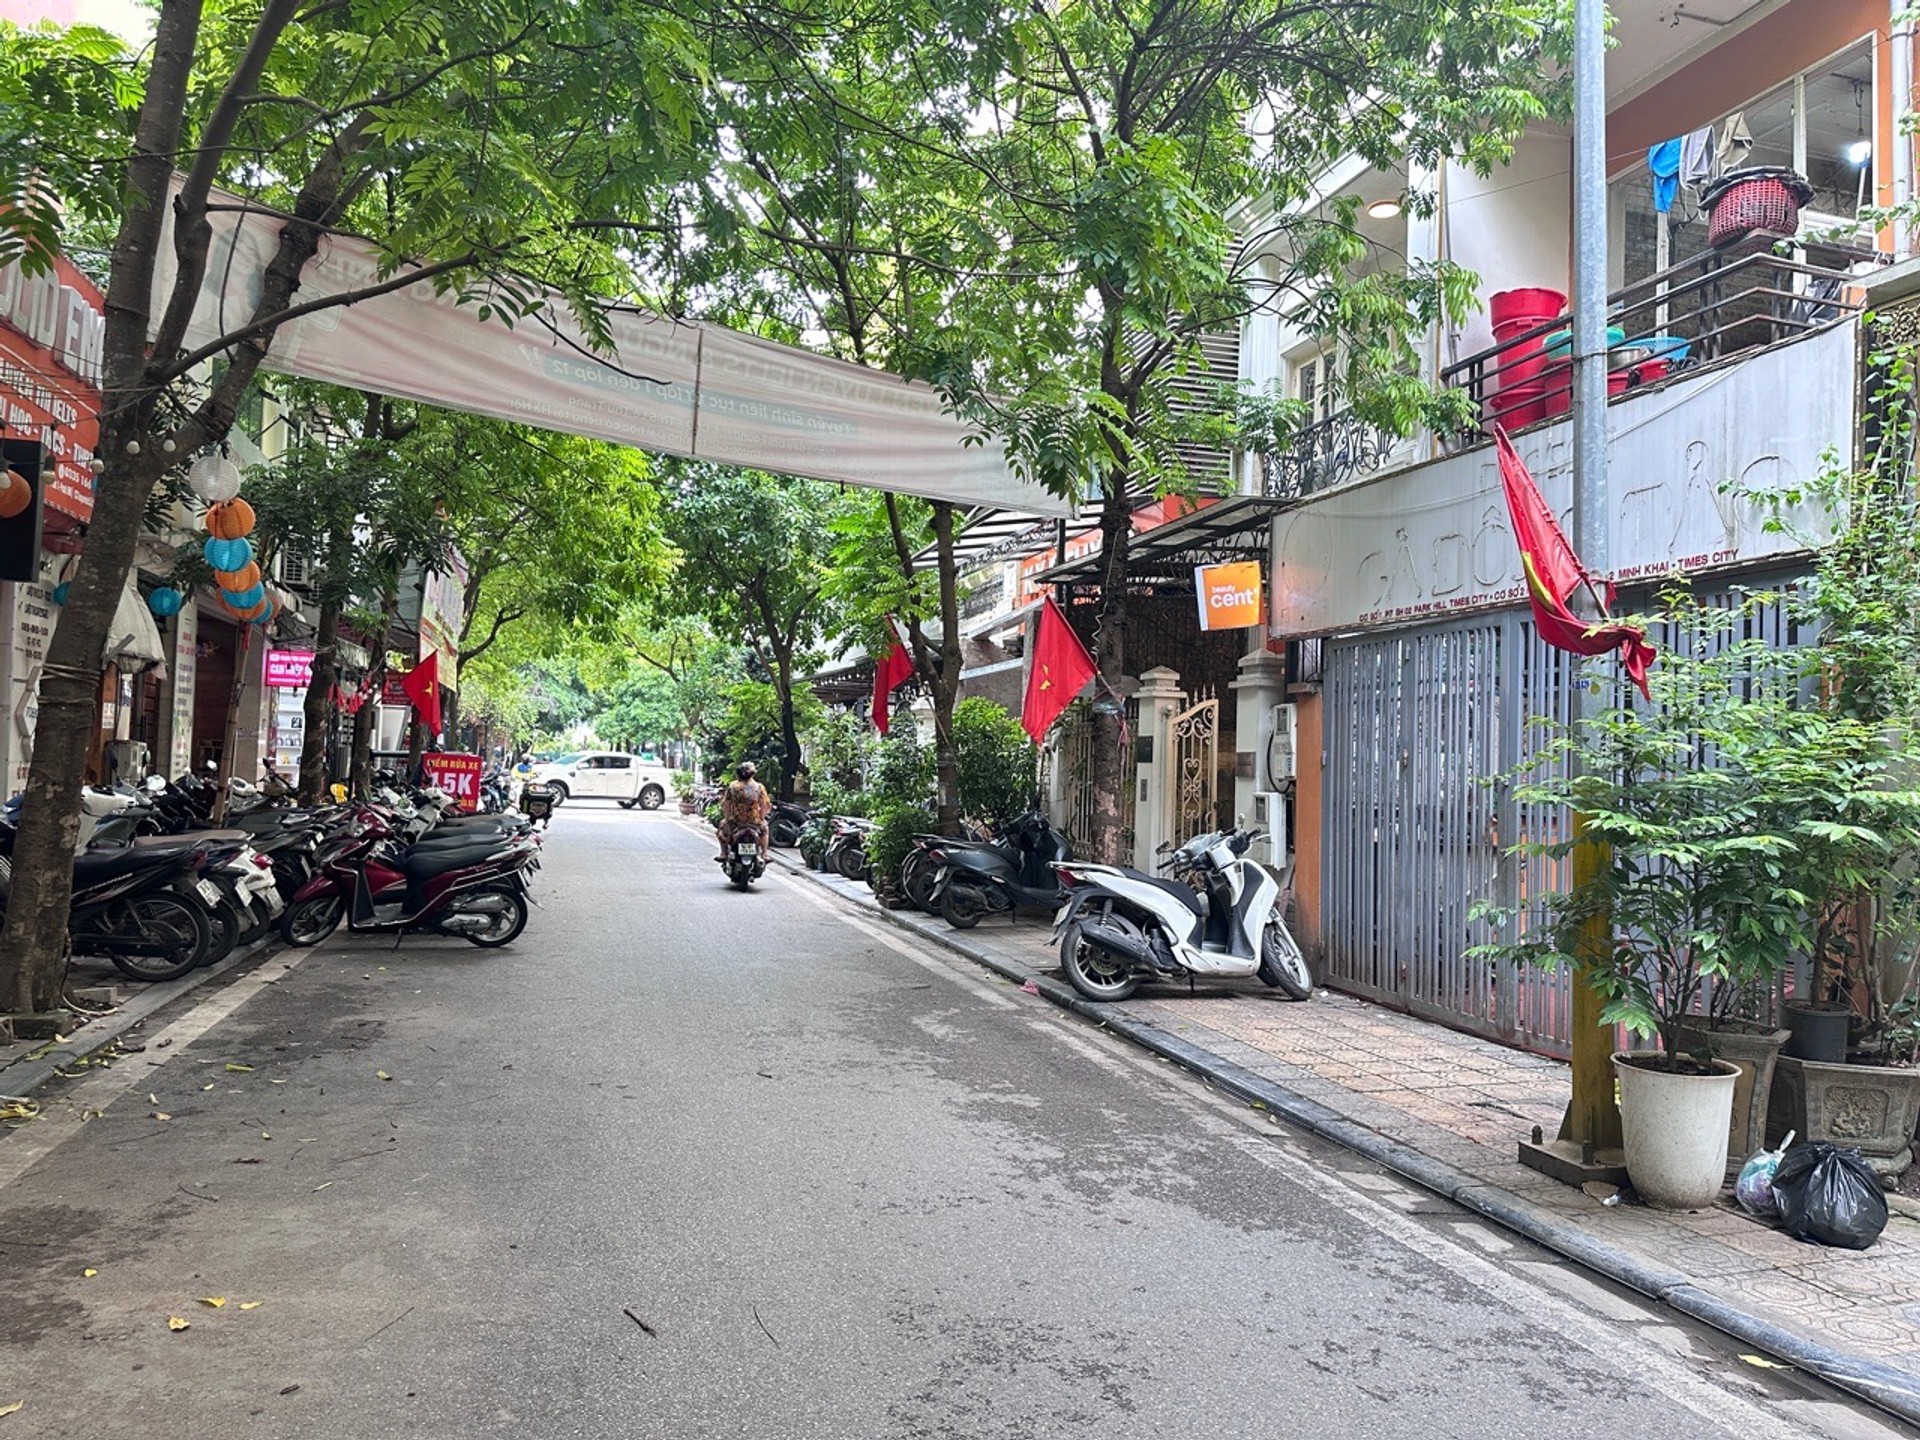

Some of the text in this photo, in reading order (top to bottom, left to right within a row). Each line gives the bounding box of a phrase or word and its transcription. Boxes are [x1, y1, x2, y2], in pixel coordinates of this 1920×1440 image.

[9, 401, 33, 437] HỌC
[52, 396, 78, 431] IELTS
[1618, 564, 1641, 579] MINH
[1644, 560, 1670, 576] KHAI
[1678, 554, 1709, 569] TIMES
[1712, 548, 1740, 564] CITY
[1413, 603, 1432, 614] PARK
[1432, 600, 1447, 611] HILL
[1449, 595, 1470, 608] TIMES
[1471, 592, 1489, 606] CITY
[467, 761, 480, 771] XE
